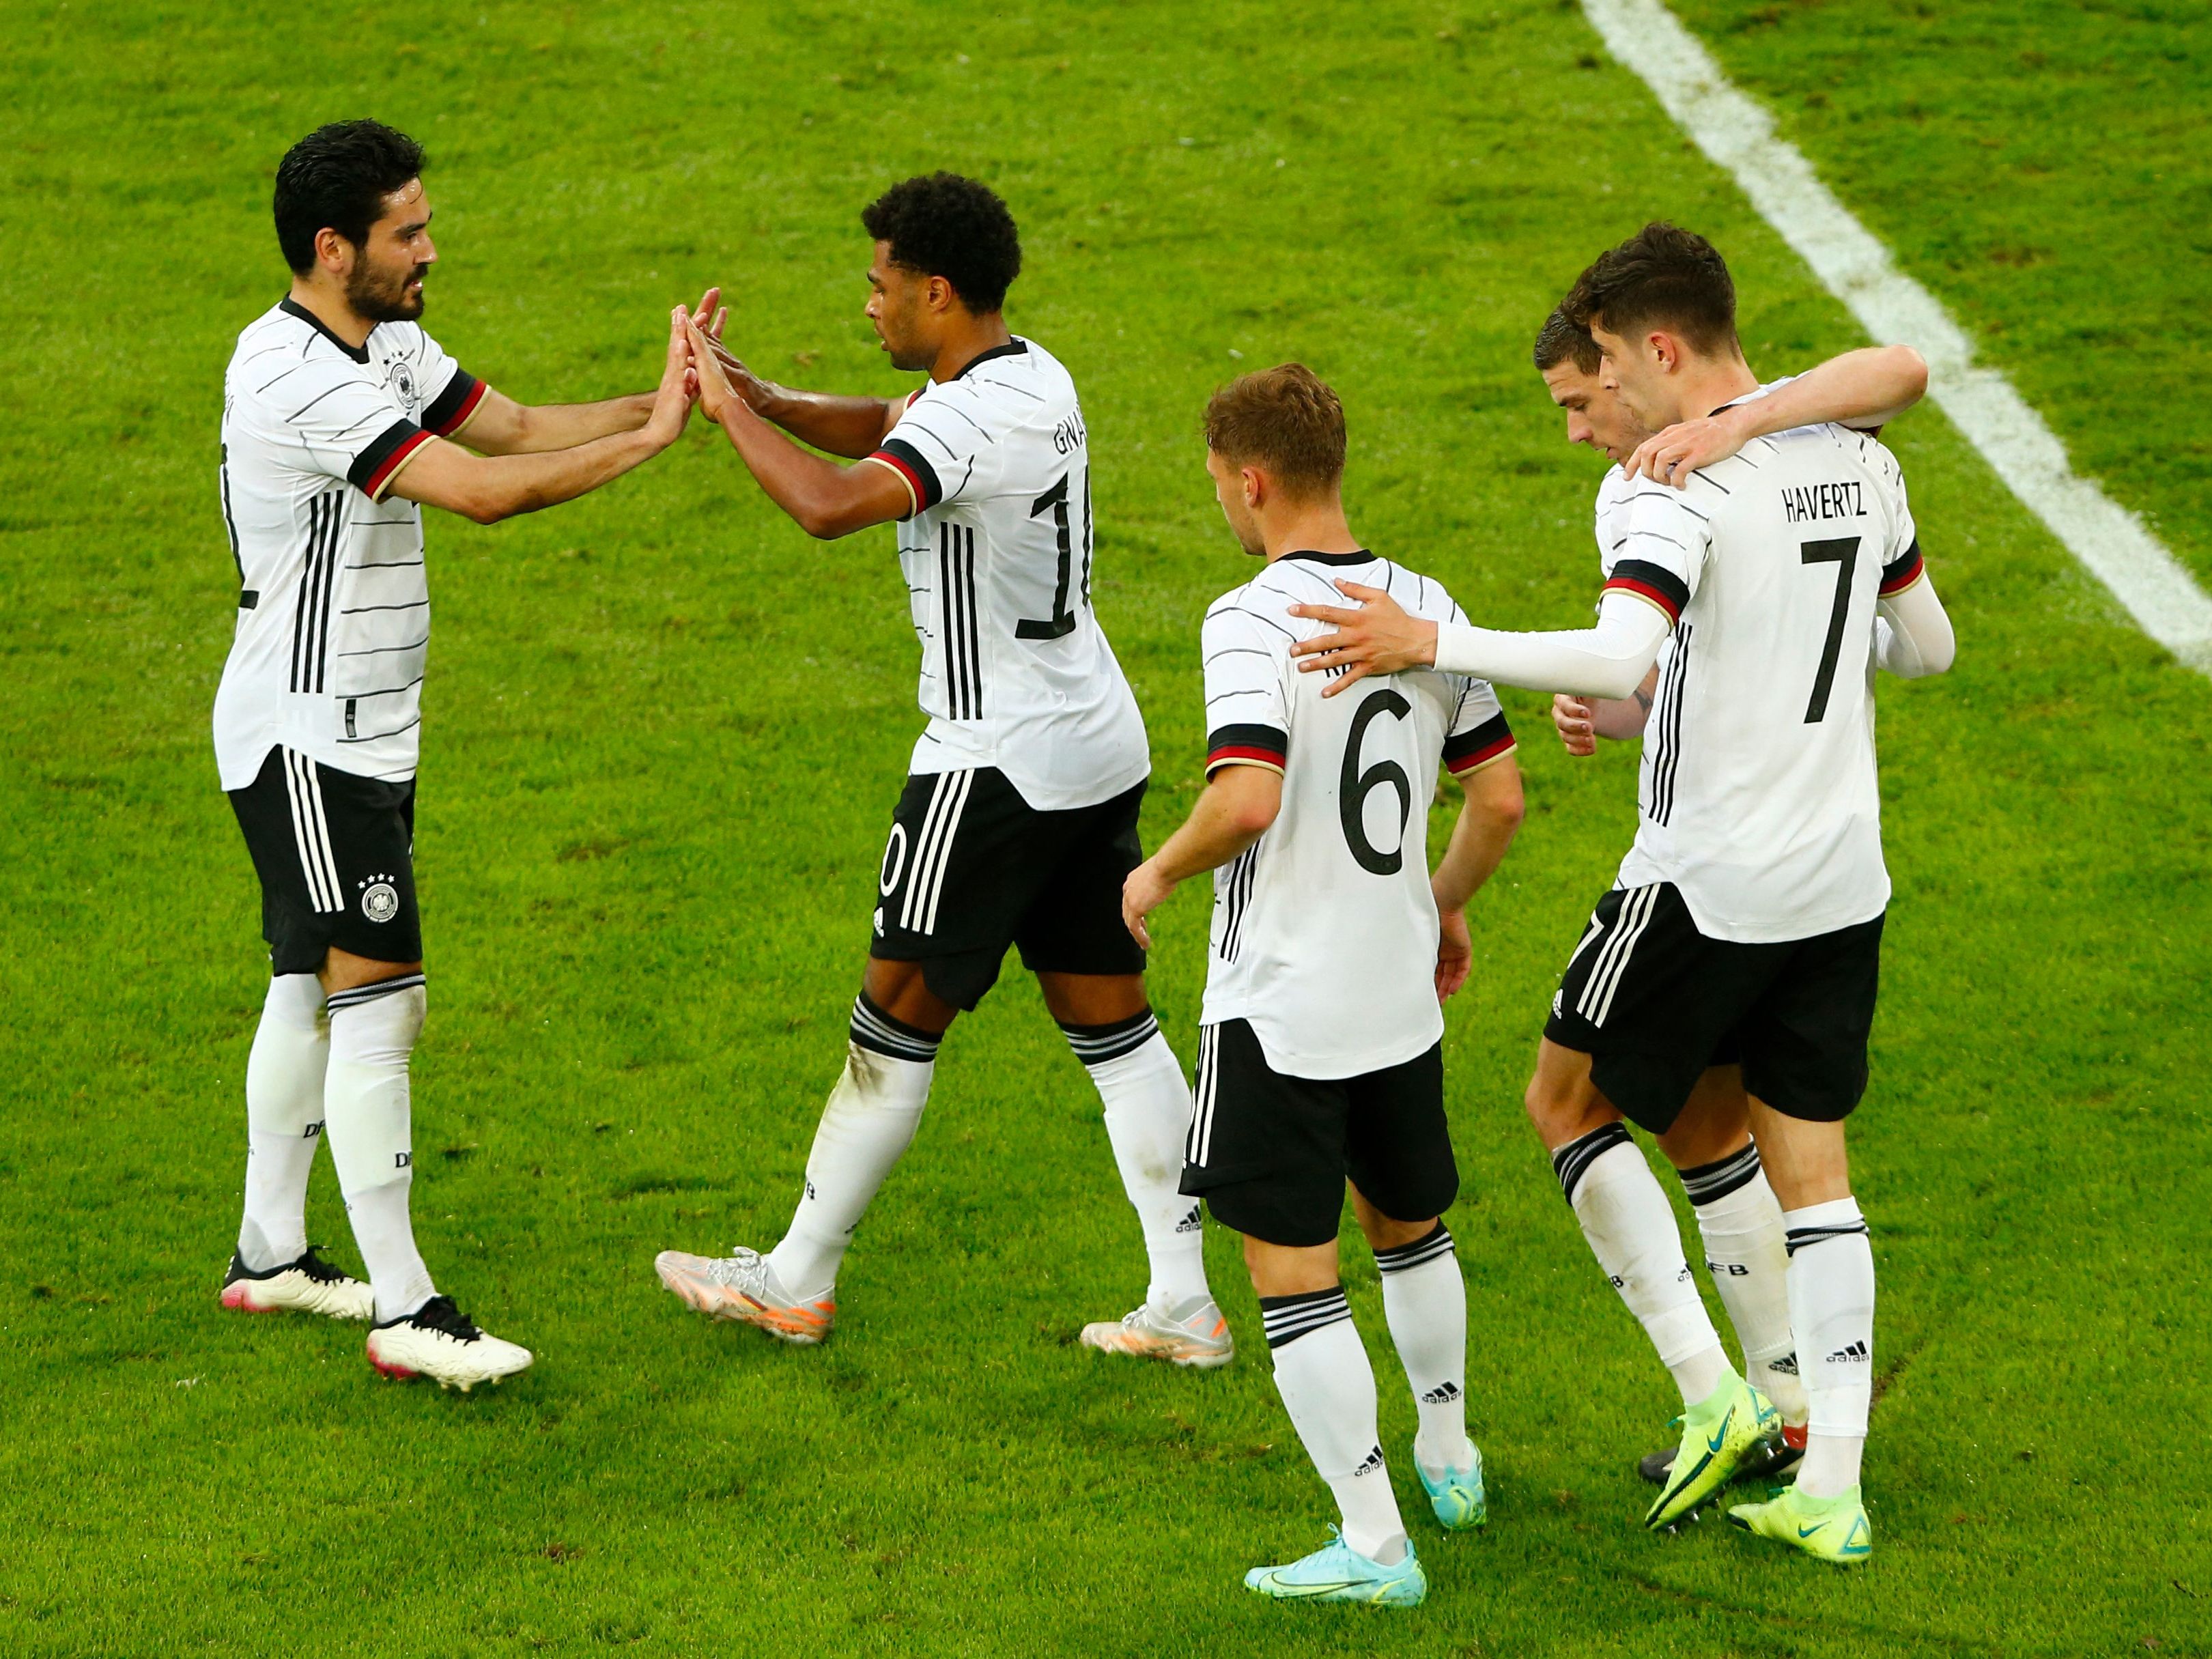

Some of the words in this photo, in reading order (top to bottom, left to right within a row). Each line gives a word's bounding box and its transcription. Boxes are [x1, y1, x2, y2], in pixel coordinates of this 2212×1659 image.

[1781, 481, 1867, 523] HAVERTZ
[1800, 537, 1862, 724] 7
[1340, 689, 1411, 875] 6
